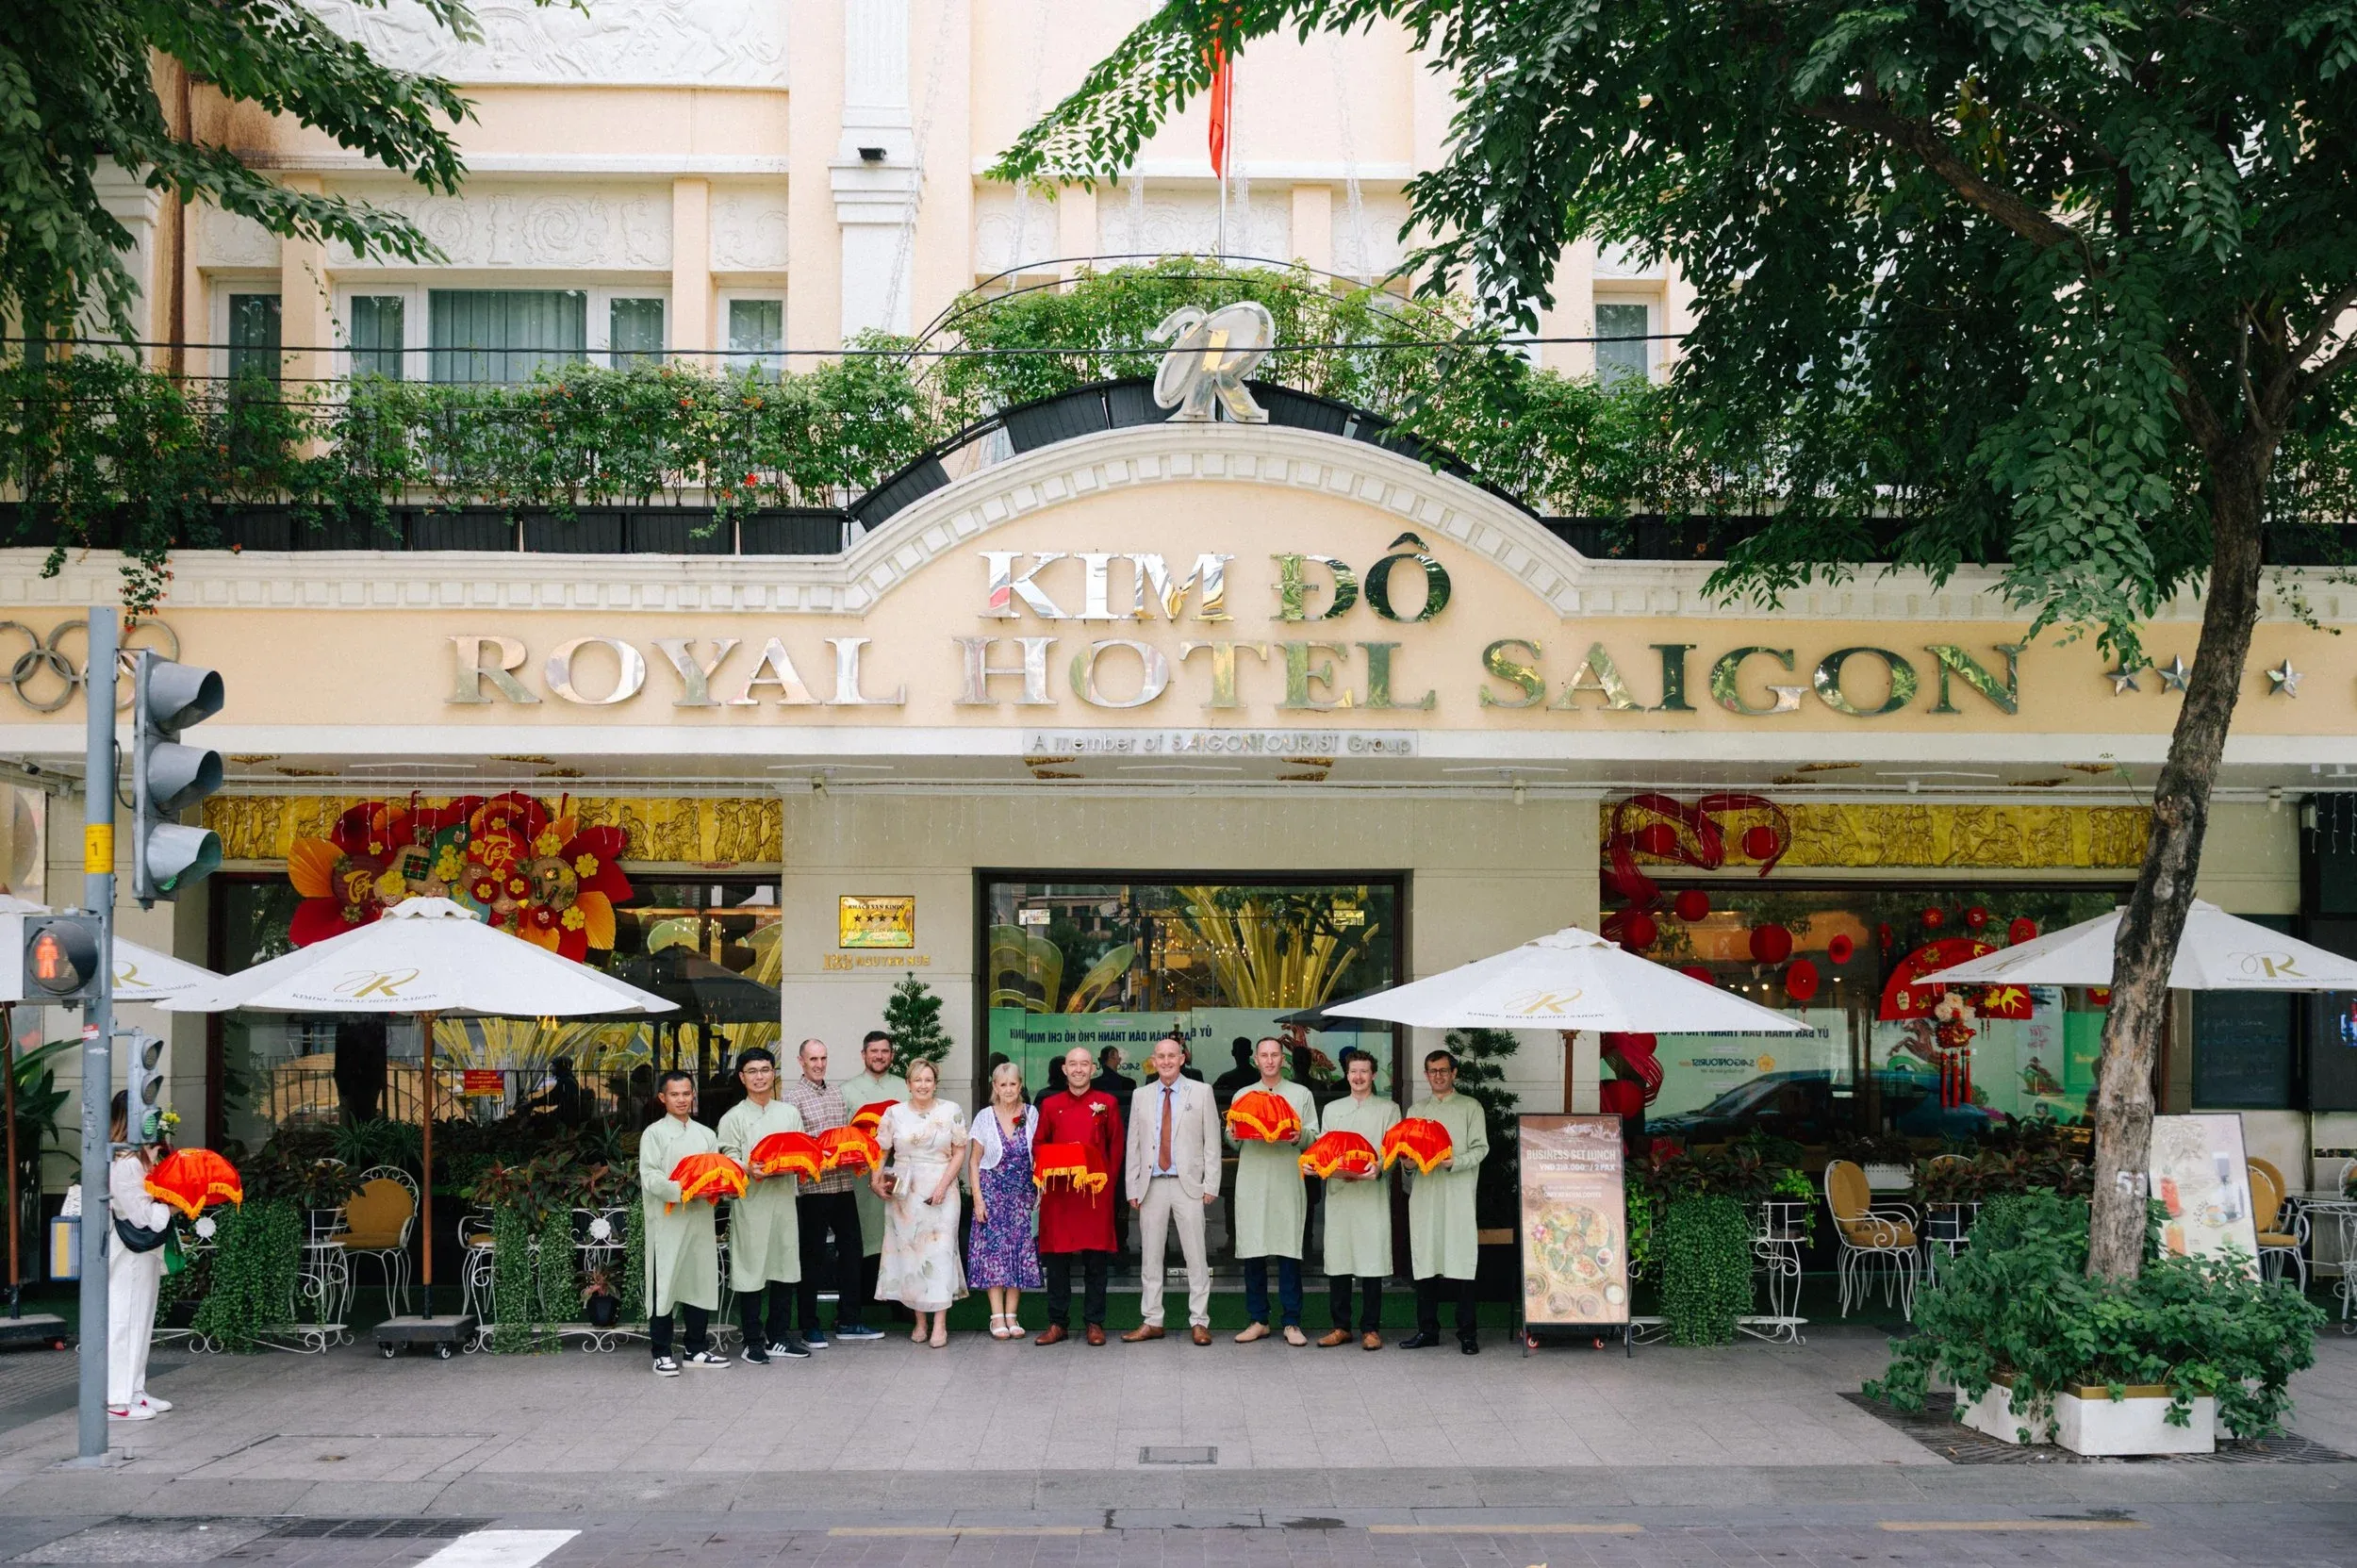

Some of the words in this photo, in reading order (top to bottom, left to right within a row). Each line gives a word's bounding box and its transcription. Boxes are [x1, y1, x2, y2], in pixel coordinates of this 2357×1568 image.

[978, 551, 1234, 620] KIM
[1270, 531, 1452, 623] ĐÔ
[444, 634, 907, 706] ROYAL
[953, 636, 1437, 712] HOTEL
[1479, 639, 2027, 717] SAIGON
[1032, 734, 1045, 751] A
[1054, 733, 1137, 751] member
[1143, 733, 1164, 751] of
[1171, 733, 1340, 751] SAIGONTOURIST
[1347, 733, 1412, 754] Group
[1527, 1149, 1570, 1161] BUSINESS
[1571, 1149, 1586, 1161] SET
[1588, 1149, 1616, 1161] LUNCH
